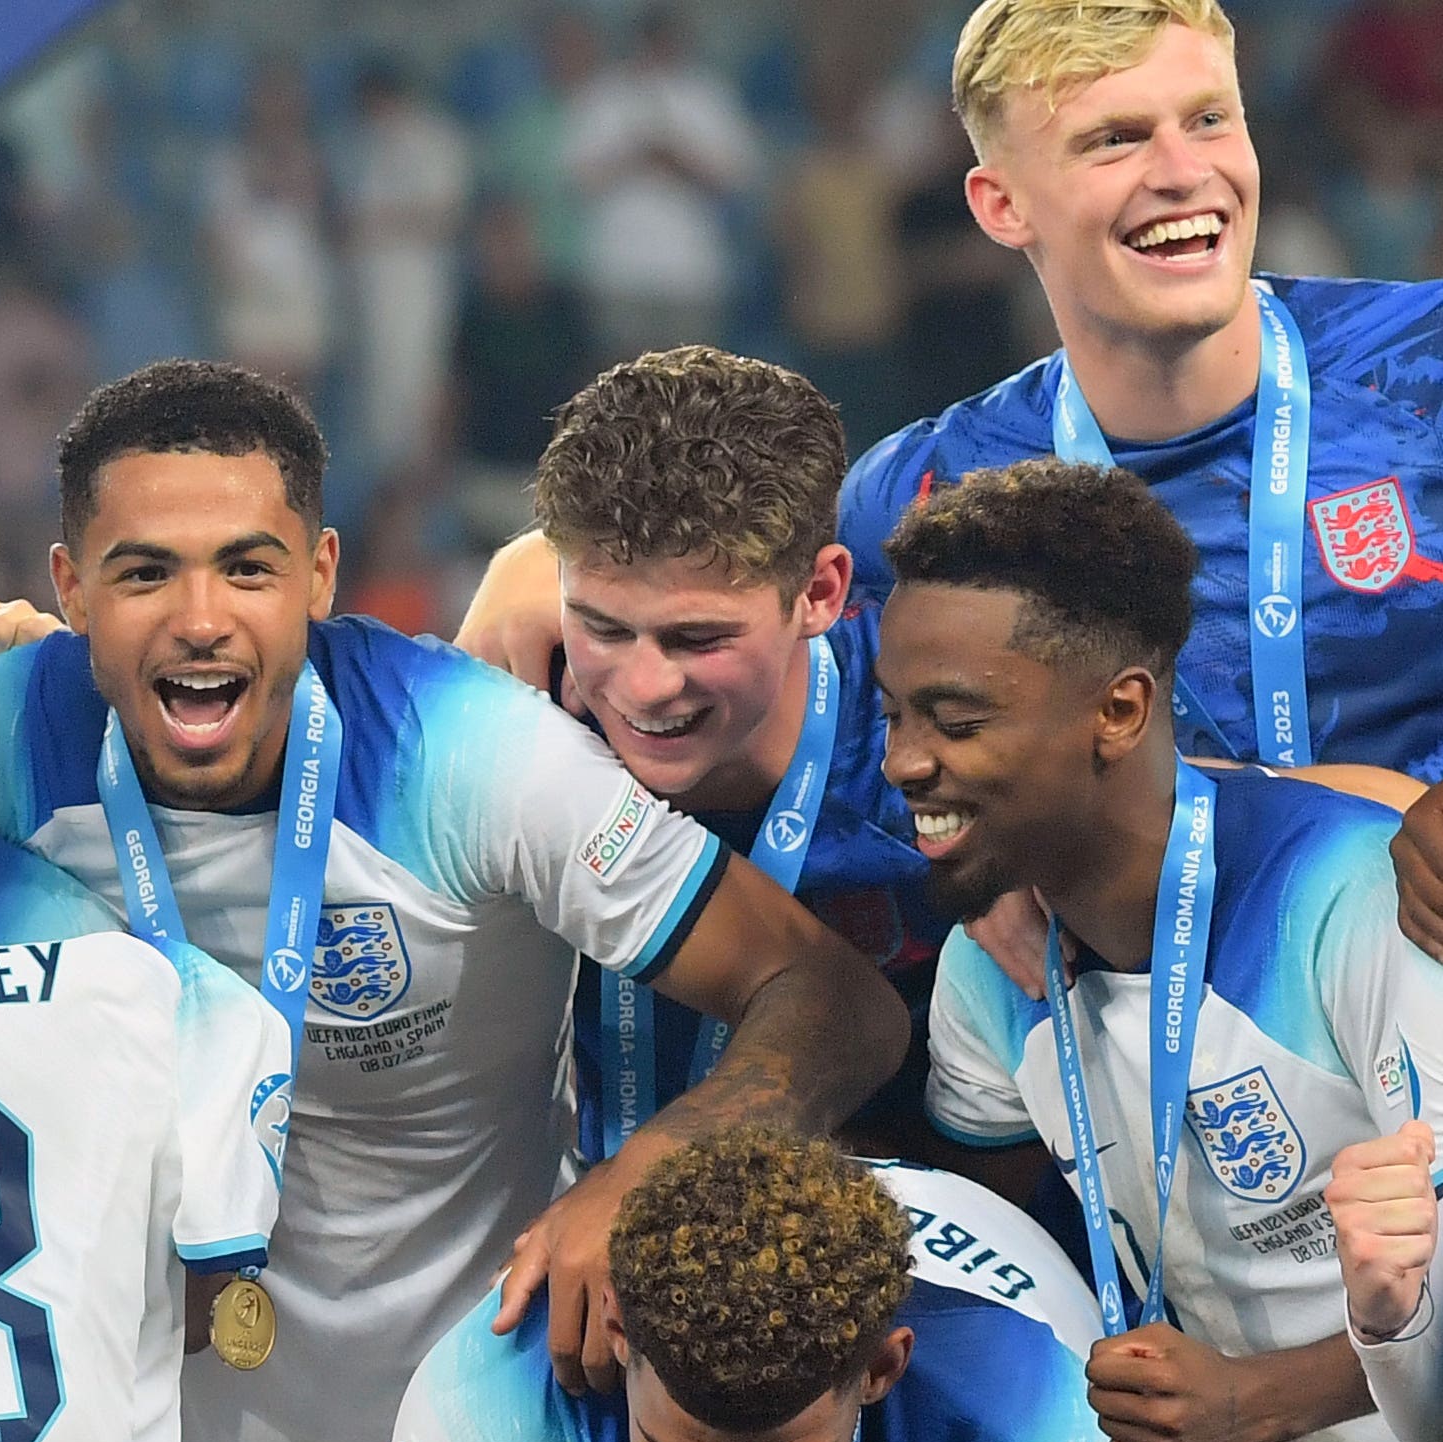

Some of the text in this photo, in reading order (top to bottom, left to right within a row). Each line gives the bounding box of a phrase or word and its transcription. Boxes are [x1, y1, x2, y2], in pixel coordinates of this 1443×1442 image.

[1270, 405, 1292, 496] GEORGIA
[1273, 690, 1293, 745] 2023
[294, 676, 328, 850] GEORGIA ROMA
[580, 832, 606, 862] UEFA
[589, 783, 649, 874] FOUNDAT
[126, 829, 159, 918] GEORGIA
[1165, 796, 1210, 1054] GEORGIA ROMANIA 2023
[307, 1000, 453, 1044] UEFA U21 EURO FINAL
[325, 1038, 397, 1062] ENGLAND
[407, 1017, 447, 1045] SPAIN
[359, 1046, 425, 1074] 08.07.23
[1052, 968, 1103, 1230] GEORGIA ROMANIA 2023
[1230, 1199, 1320, 1243] UEFA U21 EURO
[1251, 1221, 1312, 1256] ENGLAND
